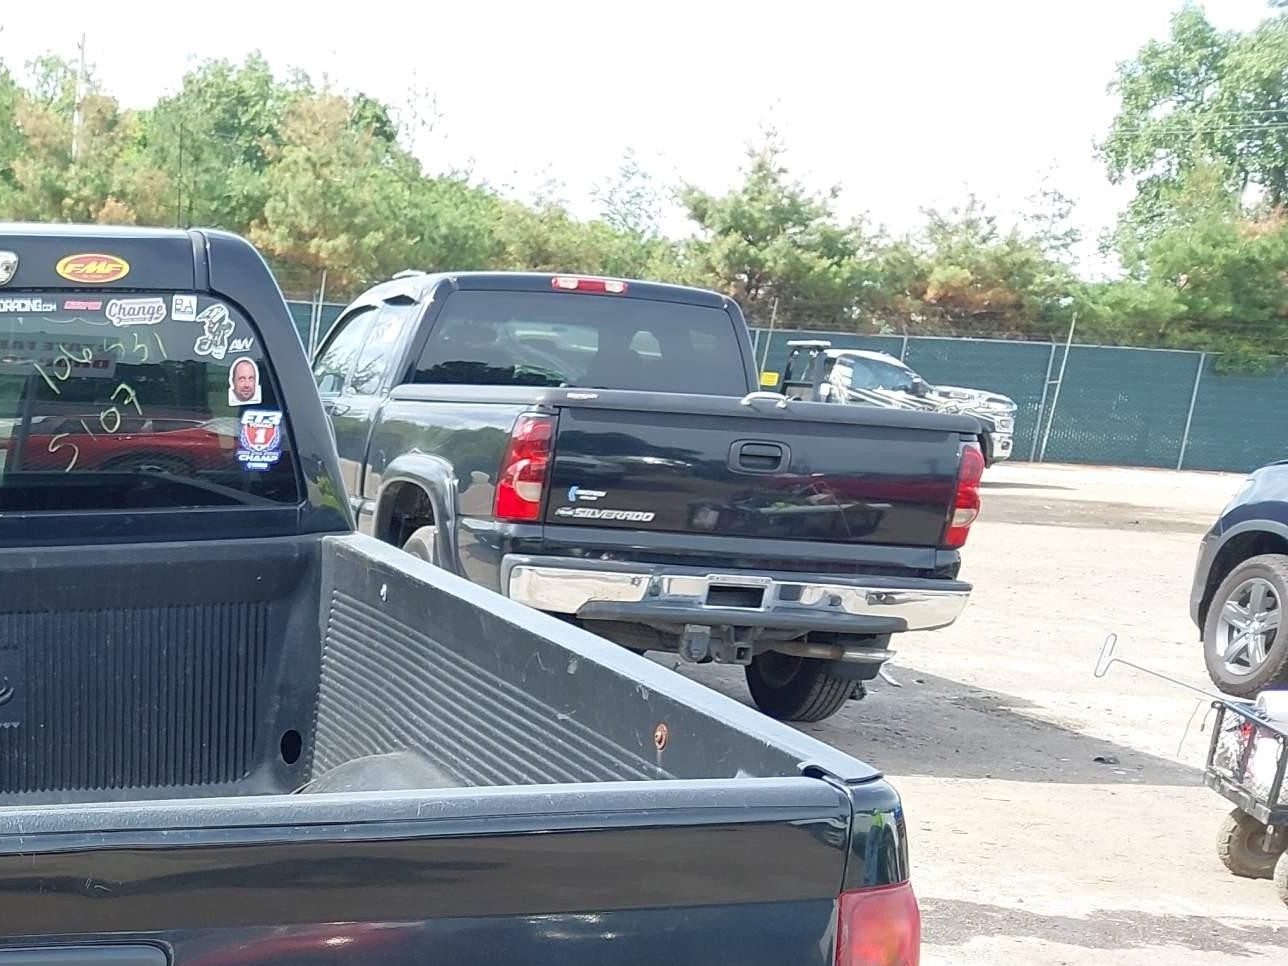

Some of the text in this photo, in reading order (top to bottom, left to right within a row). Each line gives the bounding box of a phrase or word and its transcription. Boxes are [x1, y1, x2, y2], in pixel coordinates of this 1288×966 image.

[65, 261, 123, 275] FMF
[108, 301, 164, 321] Change
[229, 337, 254, 351] AW
[241, 410, 282, 425] ET3
[238, 453, 279, 462] CHAMP
[572, 507, 655, 522] SILVERADO
